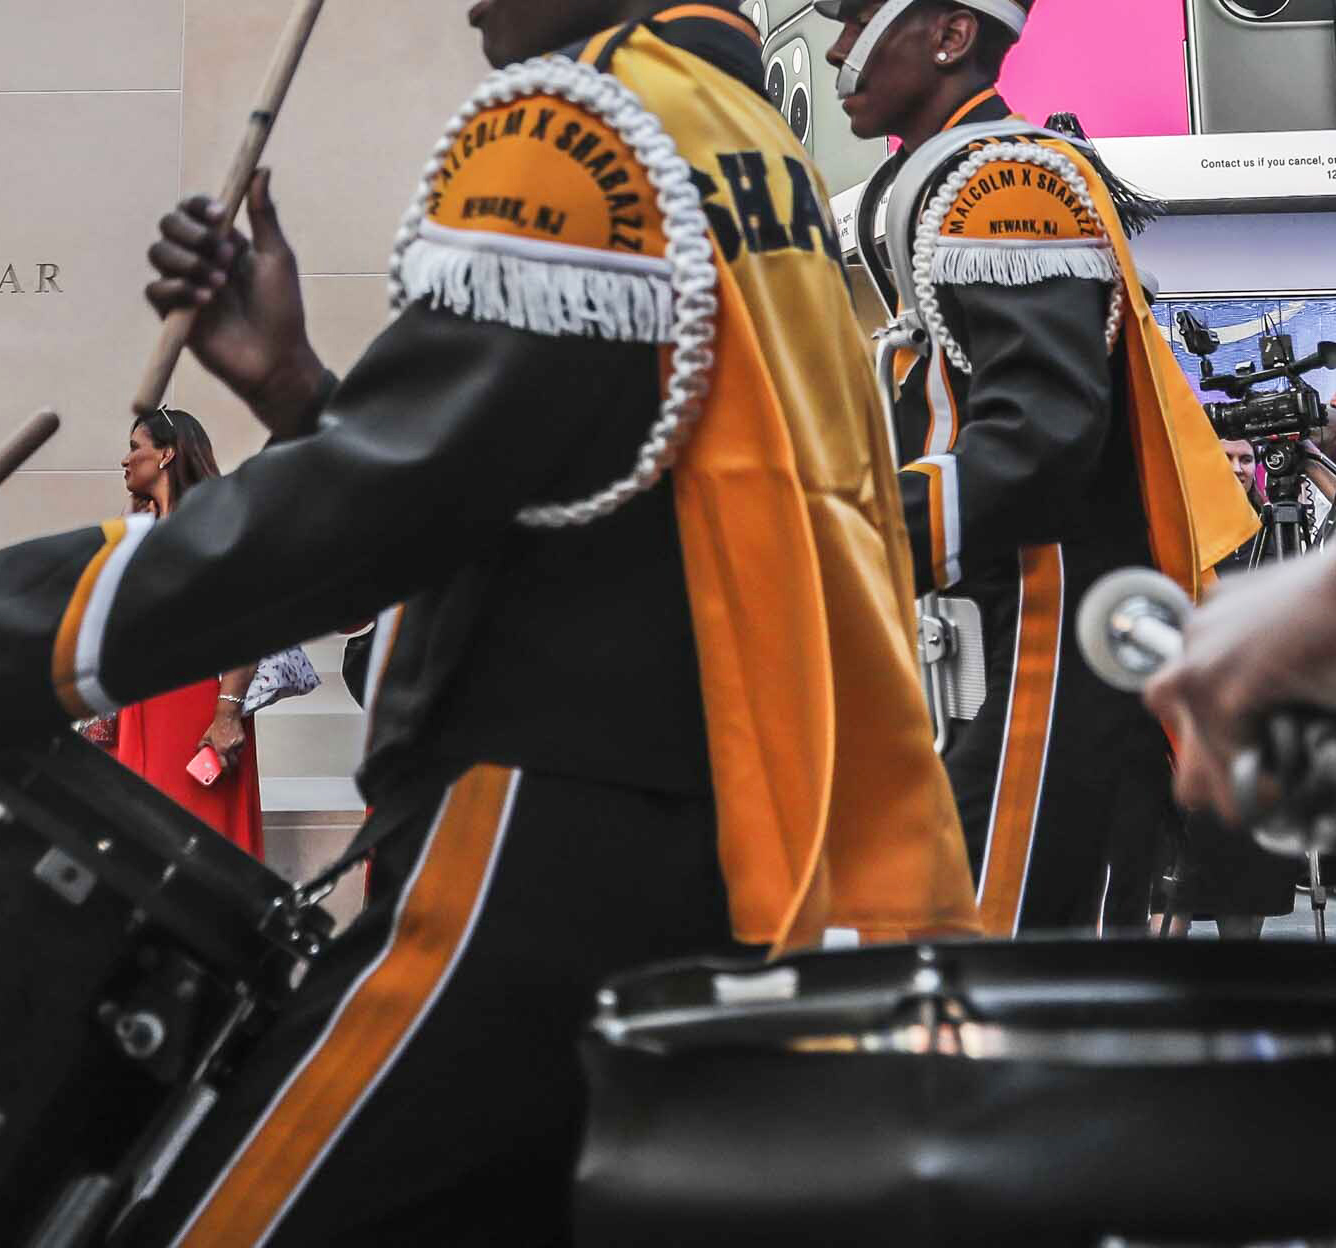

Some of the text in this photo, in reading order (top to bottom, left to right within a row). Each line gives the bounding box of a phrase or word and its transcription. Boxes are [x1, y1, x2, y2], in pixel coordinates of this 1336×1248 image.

[530, 109, 556, 141] X
[555, 121, 644, 251] SHABAZZ
[1201, 158, 1241, 169] Contact
[1243, 159, 1255, 168] us
[1257, 156, 1265, 167] if
[1267, 158, 1286, 169] you
[1288, 155, 1325, 167] cancel,
[689, 150, 841, 265] SHA
[949, 168, 1095, 236] MALCOLM X SHABAZZ
[1043, 220, 1058, 236] NJ
